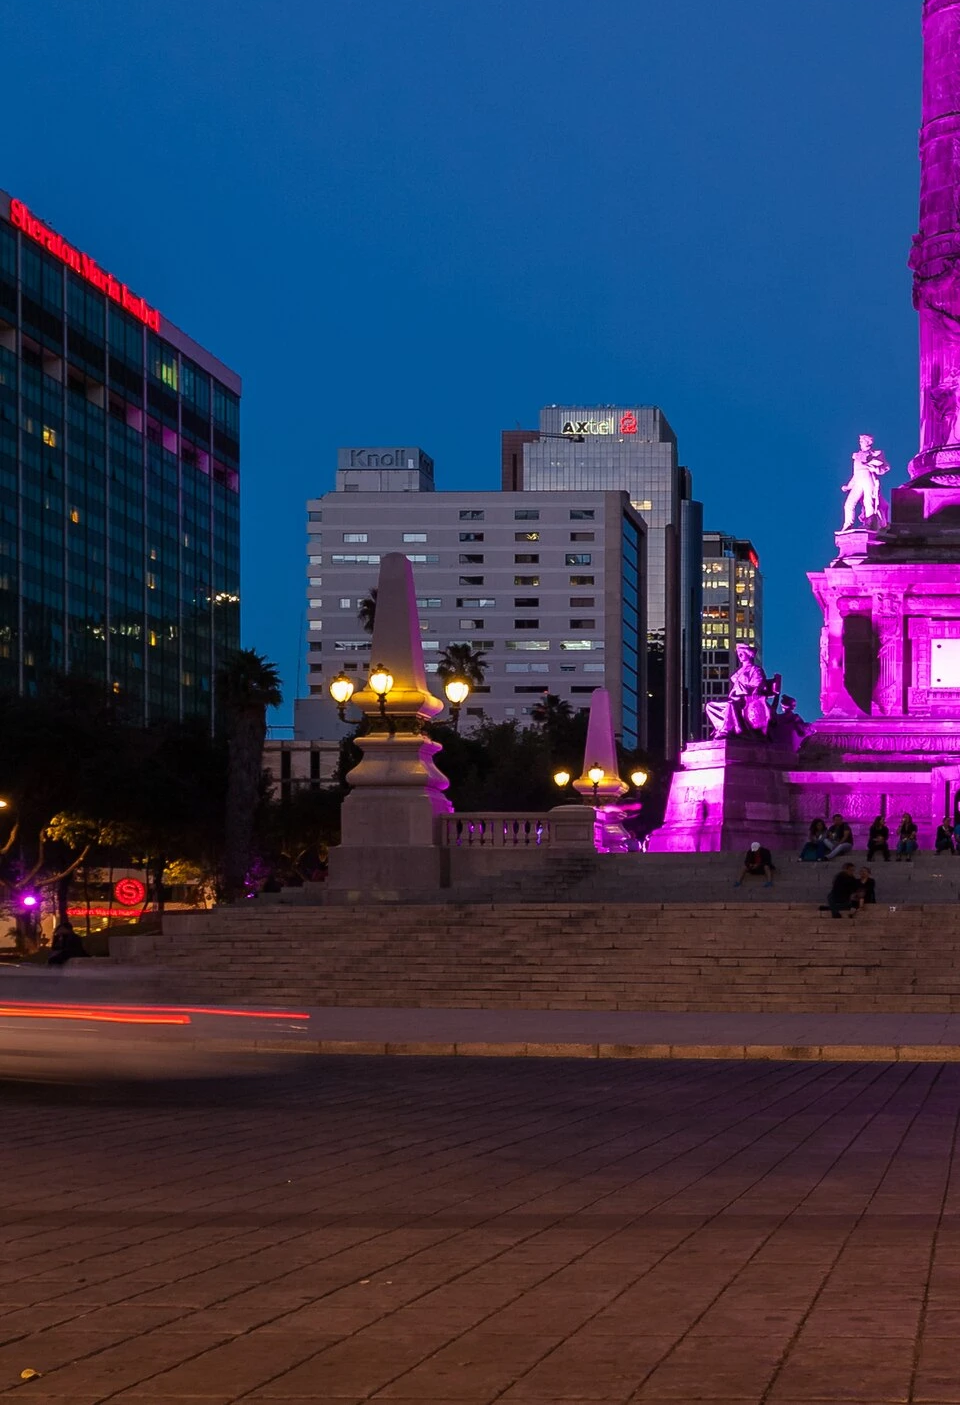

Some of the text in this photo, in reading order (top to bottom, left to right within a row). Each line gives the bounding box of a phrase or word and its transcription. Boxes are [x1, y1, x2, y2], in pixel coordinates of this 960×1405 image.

[10, 198, 160, 333] Sheraton Maria Isabel
[350, 450, 406, 467] Knoll
[122, 884, 137, 899] S
